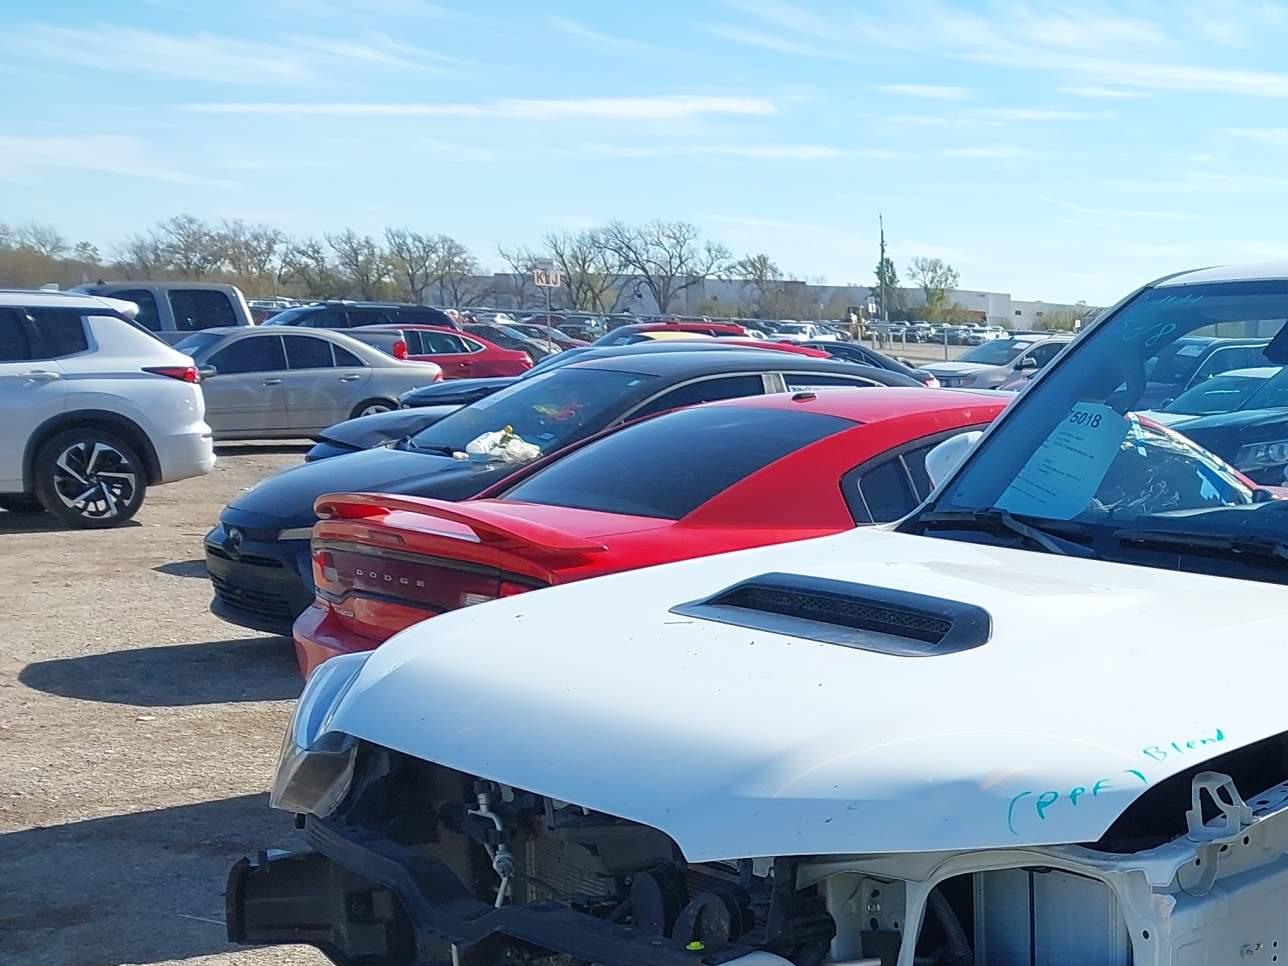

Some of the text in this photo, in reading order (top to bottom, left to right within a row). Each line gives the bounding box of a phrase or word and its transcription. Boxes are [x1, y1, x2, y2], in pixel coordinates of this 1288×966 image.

[1068, 410, 1103, 429] 5018
[355, 567, 426, 588] DODGE
[1142, 728, 1226, 762] Blend
